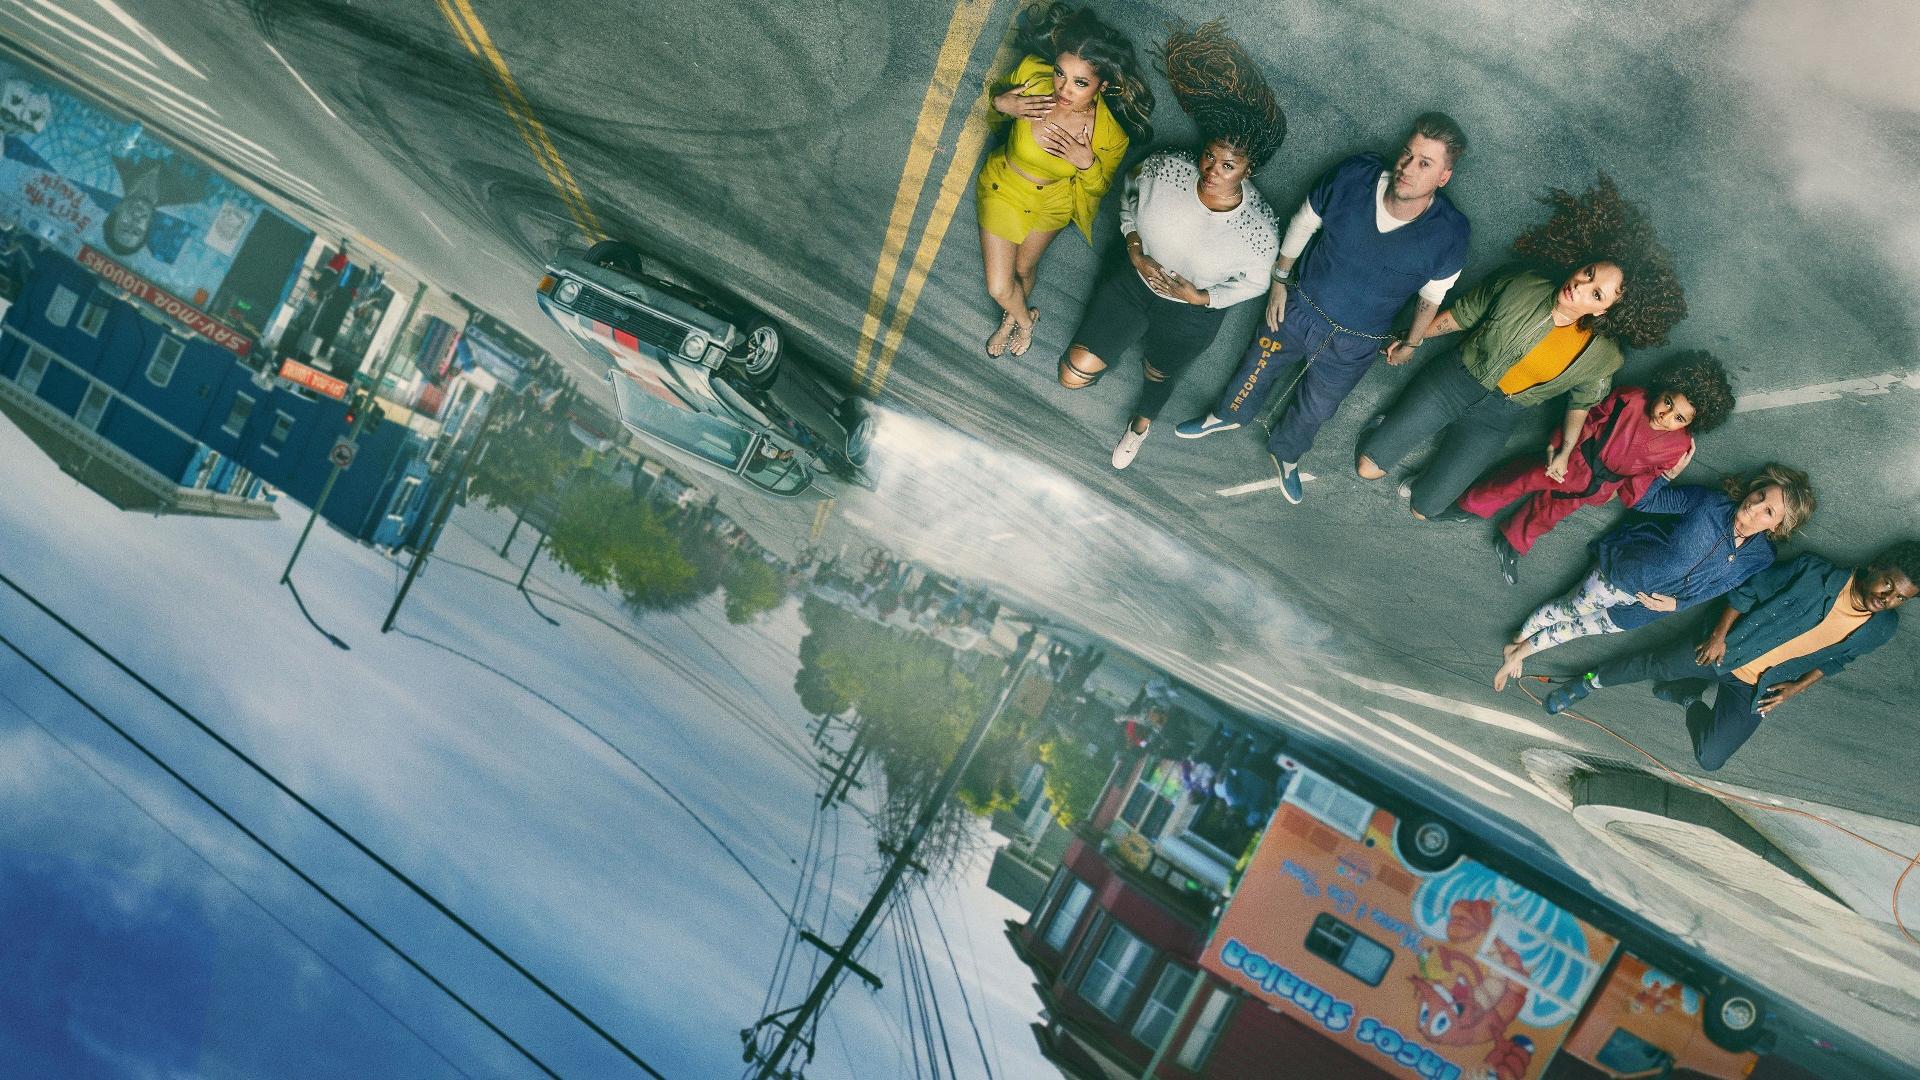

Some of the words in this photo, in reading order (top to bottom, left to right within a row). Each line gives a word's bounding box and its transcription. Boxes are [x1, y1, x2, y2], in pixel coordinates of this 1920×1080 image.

[83, 252, 151, 299] LIQUORS
[153, 290, 249, 351] SAV-MOR
[1259, 337, 1282, 352] OP
[1230, 350, 1271, 412] PRISONER
[1219, 938, 1358, 1032] Sinaloa
